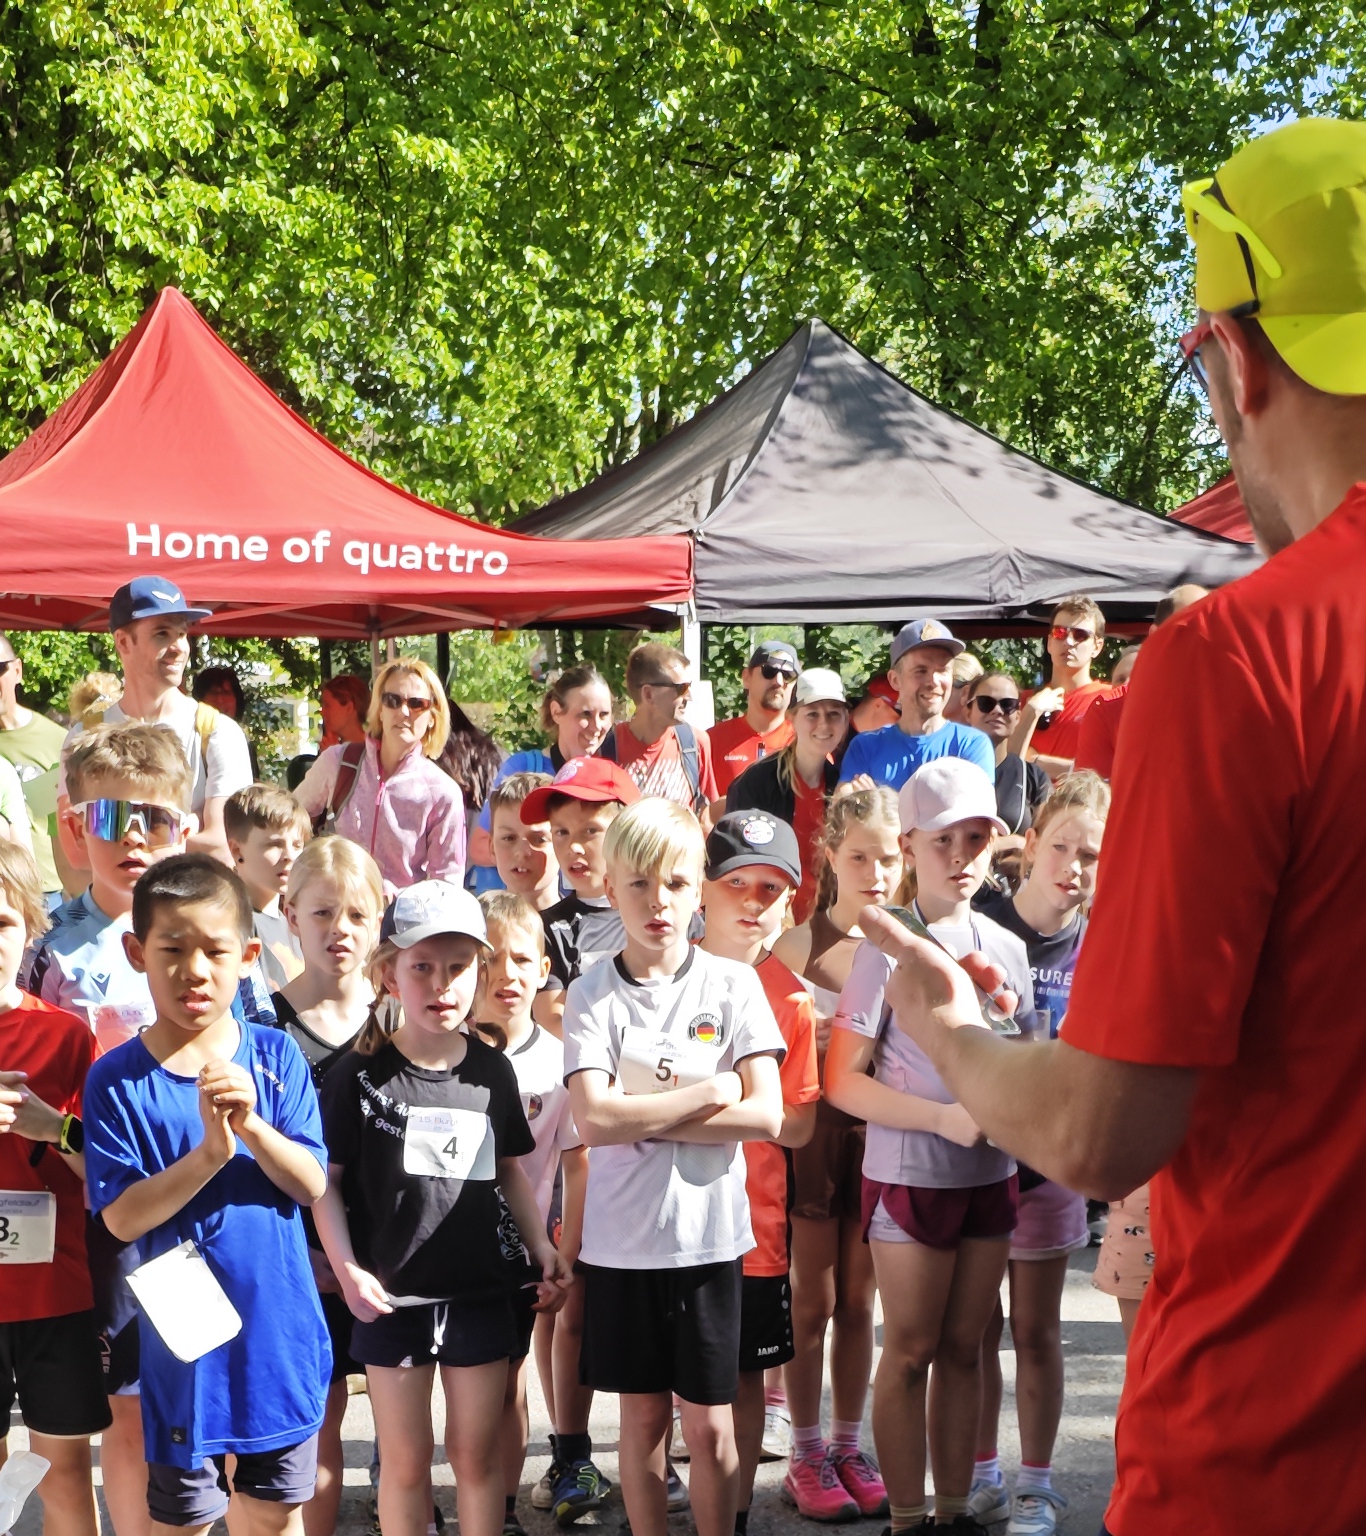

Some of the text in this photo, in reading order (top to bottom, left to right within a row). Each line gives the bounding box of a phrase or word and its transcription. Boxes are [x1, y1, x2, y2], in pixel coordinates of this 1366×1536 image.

[126, 522, 509, 576] Home of quattro
[655, 1057, 673, 1082] 5
[357, 1070, 393, 1107] Kannst
[442, 1136, 458, 1160] 4
[9, 1231, 20, 1245] 2
[757, 1345, 779, 1356] JAKO
